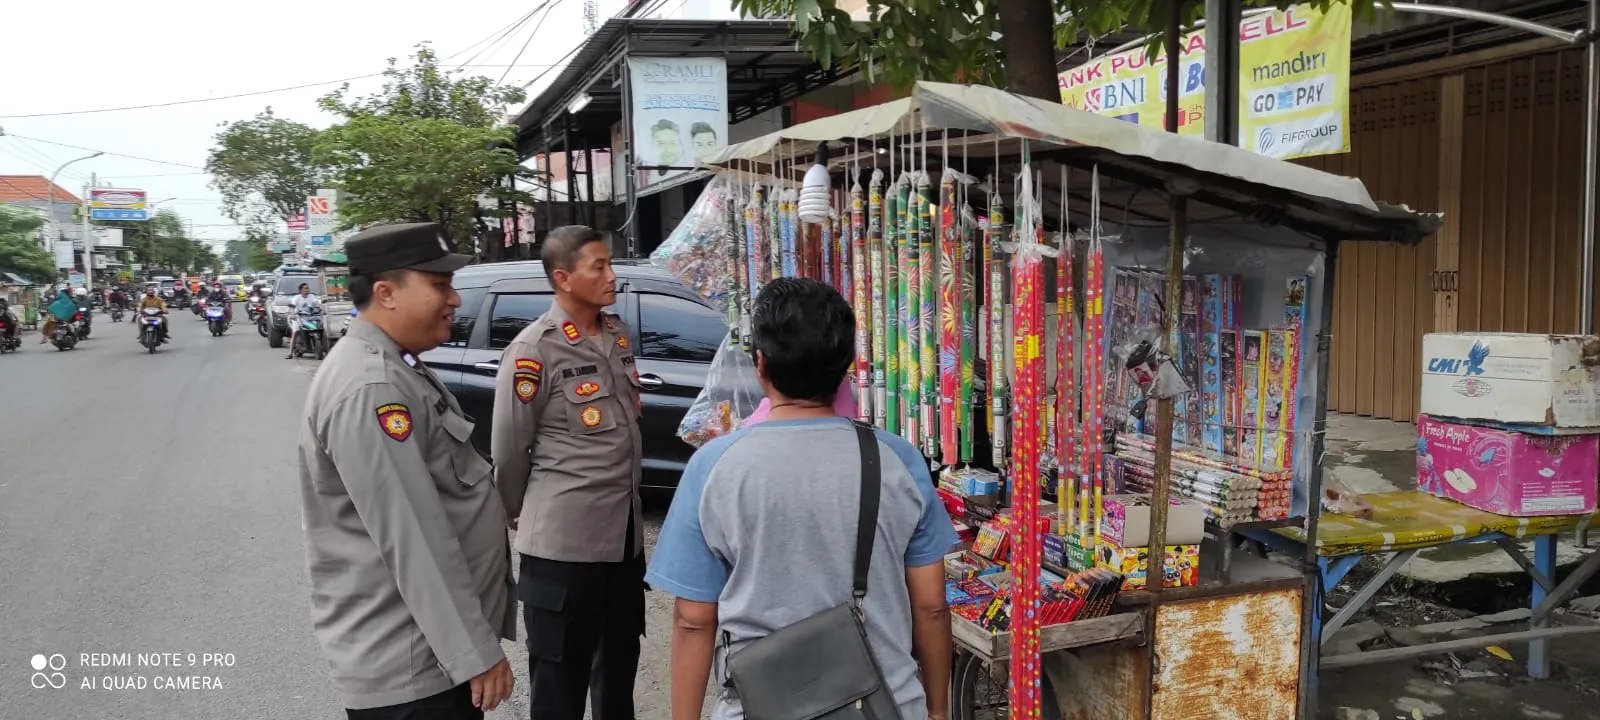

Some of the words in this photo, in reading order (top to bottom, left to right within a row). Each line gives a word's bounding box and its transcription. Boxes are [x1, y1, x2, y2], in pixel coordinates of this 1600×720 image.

[1057, 63, 1103, 89] ANK
[1239, 10, 1307, 41] ELL
[1253, 51, 1326, 82] mandiri
[1104, 77, 1145, 110] BNI
[1281, 124, 1338, 144] FIFGROUP
[1425, 422, 1445, 440] Fresh
[1446, 426, 1470, 446] Apple
